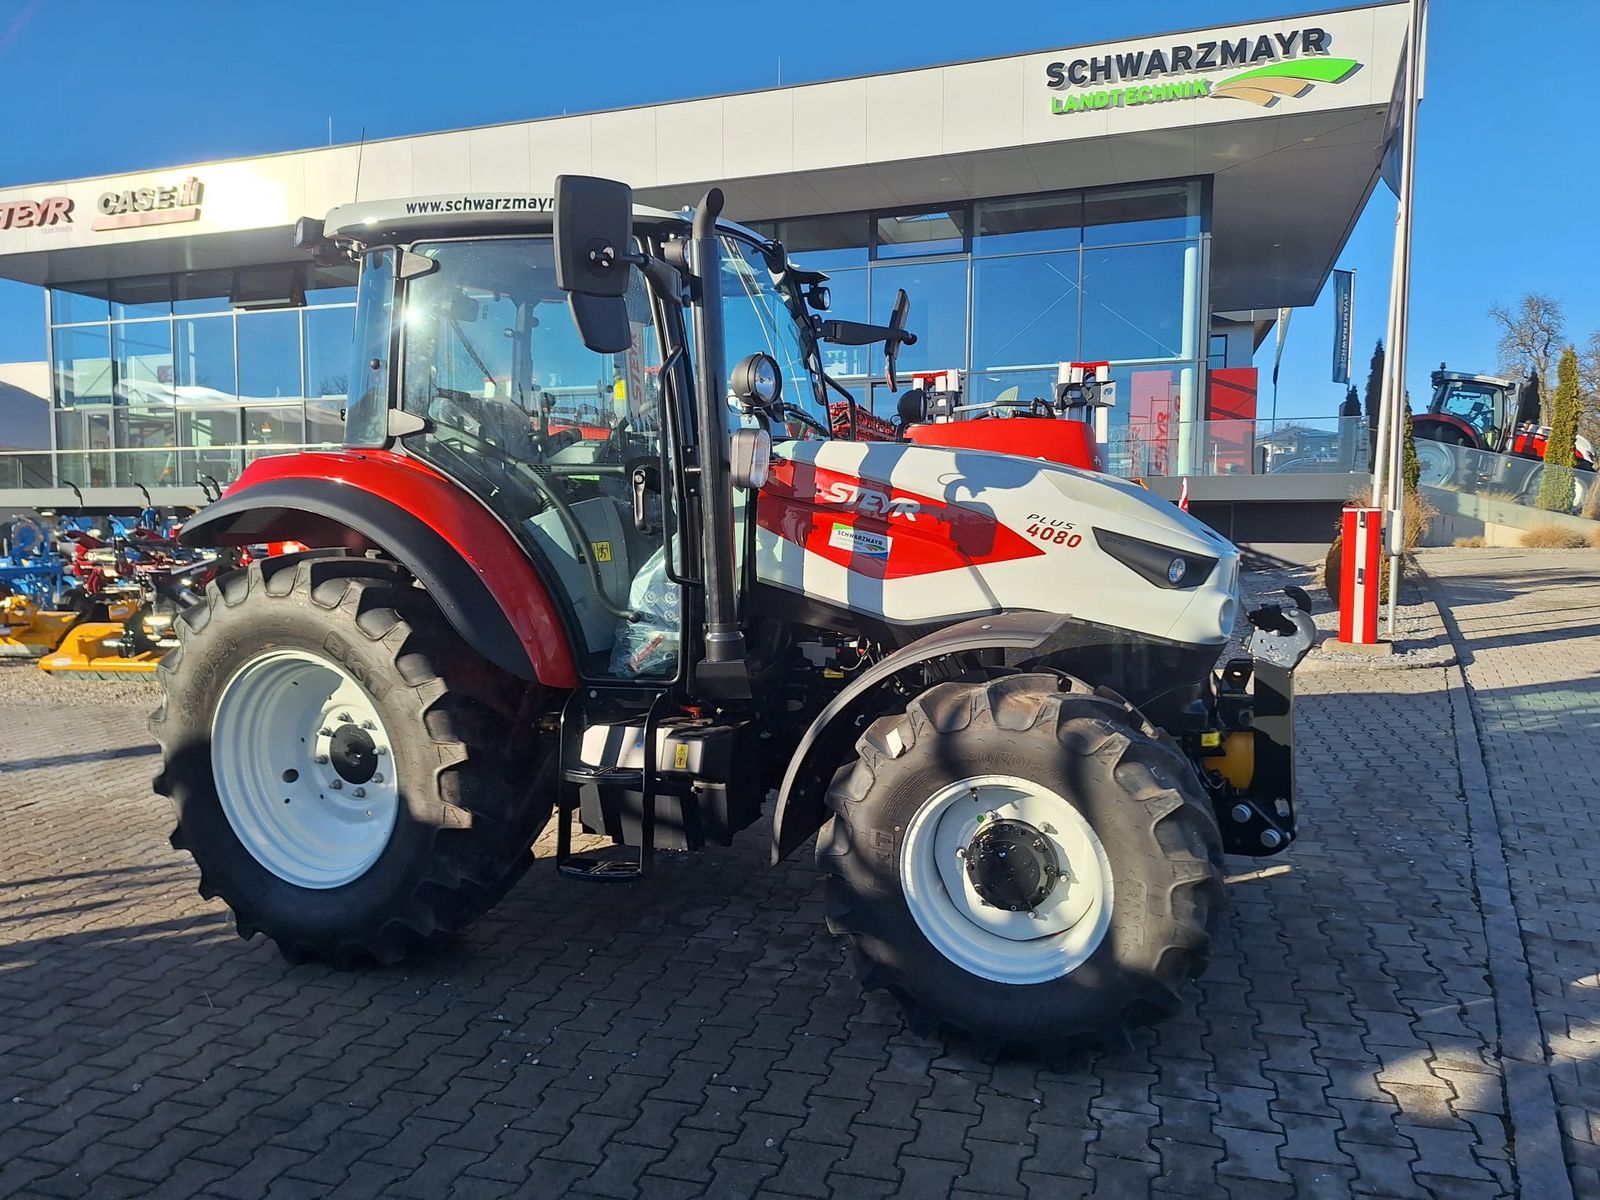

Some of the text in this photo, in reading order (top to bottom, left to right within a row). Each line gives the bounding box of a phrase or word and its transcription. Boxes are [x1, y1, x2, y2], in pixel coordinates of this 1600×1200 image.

[1046, 27, 1325, 88] SCHWARZMAYR
[1052, 78, 1209, 114] LANDTECHNIK
[98, 186, 173, 215] CASE
[823, 482, 921, 522] STEYR
[1026, 513, 1076, 530] PLUS
[1026, 523, 1083, 548] 4080
[837, 529, 883, 546] SCHWARZMAYR
